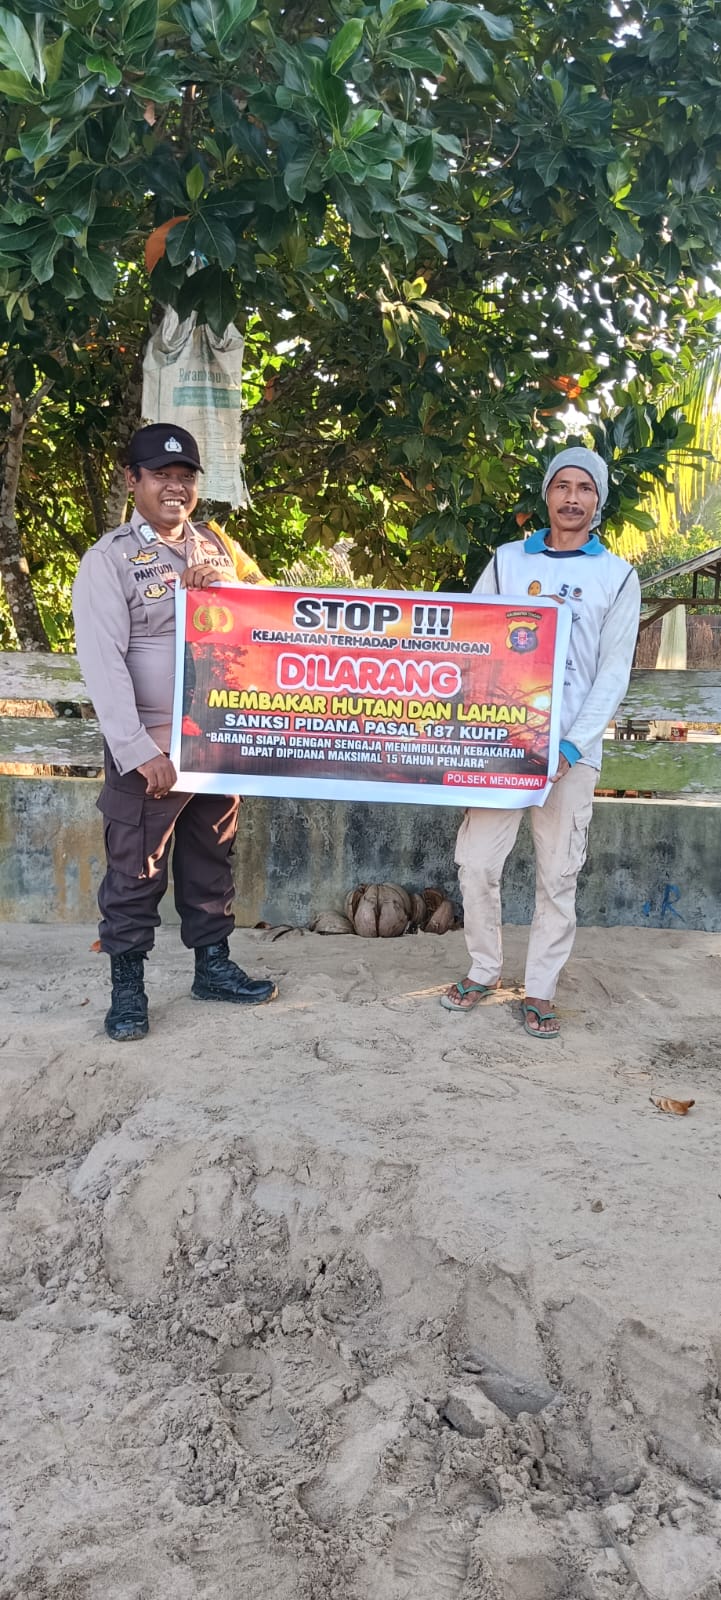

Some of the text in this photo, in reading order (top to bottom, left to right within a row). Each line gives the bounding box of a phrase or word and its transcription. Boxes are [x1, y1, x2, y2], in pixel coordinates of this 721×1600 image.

[133, 563, 173, 582] PAHYUDI
[558, 584, 570, 597] 5
[294, 598, 452, 636] STOP !!!
[252, 630, 490, 654] KEJAHATAN TERHADAP LINGKUNGAN
[278, 655, 460, 696] DILARANG
[208, 689, 527, 724] MEMBAKAR HUTAN DAN LAHAN
[224, 713, 508, 741] SANKSI PIDANA PASAL 187 KUHP
[206, 732, 525, 759] "BARANG SIAPA DENGAN SENGAJA MENIMBULKAN KEBAKARAN
[241, 745, 489, 769] DAPAT DIPIDANA MAKSIMAL 15 TAHUN PENJARA"
[447, 773, 544, 787] POLSEK MENDAWAI
